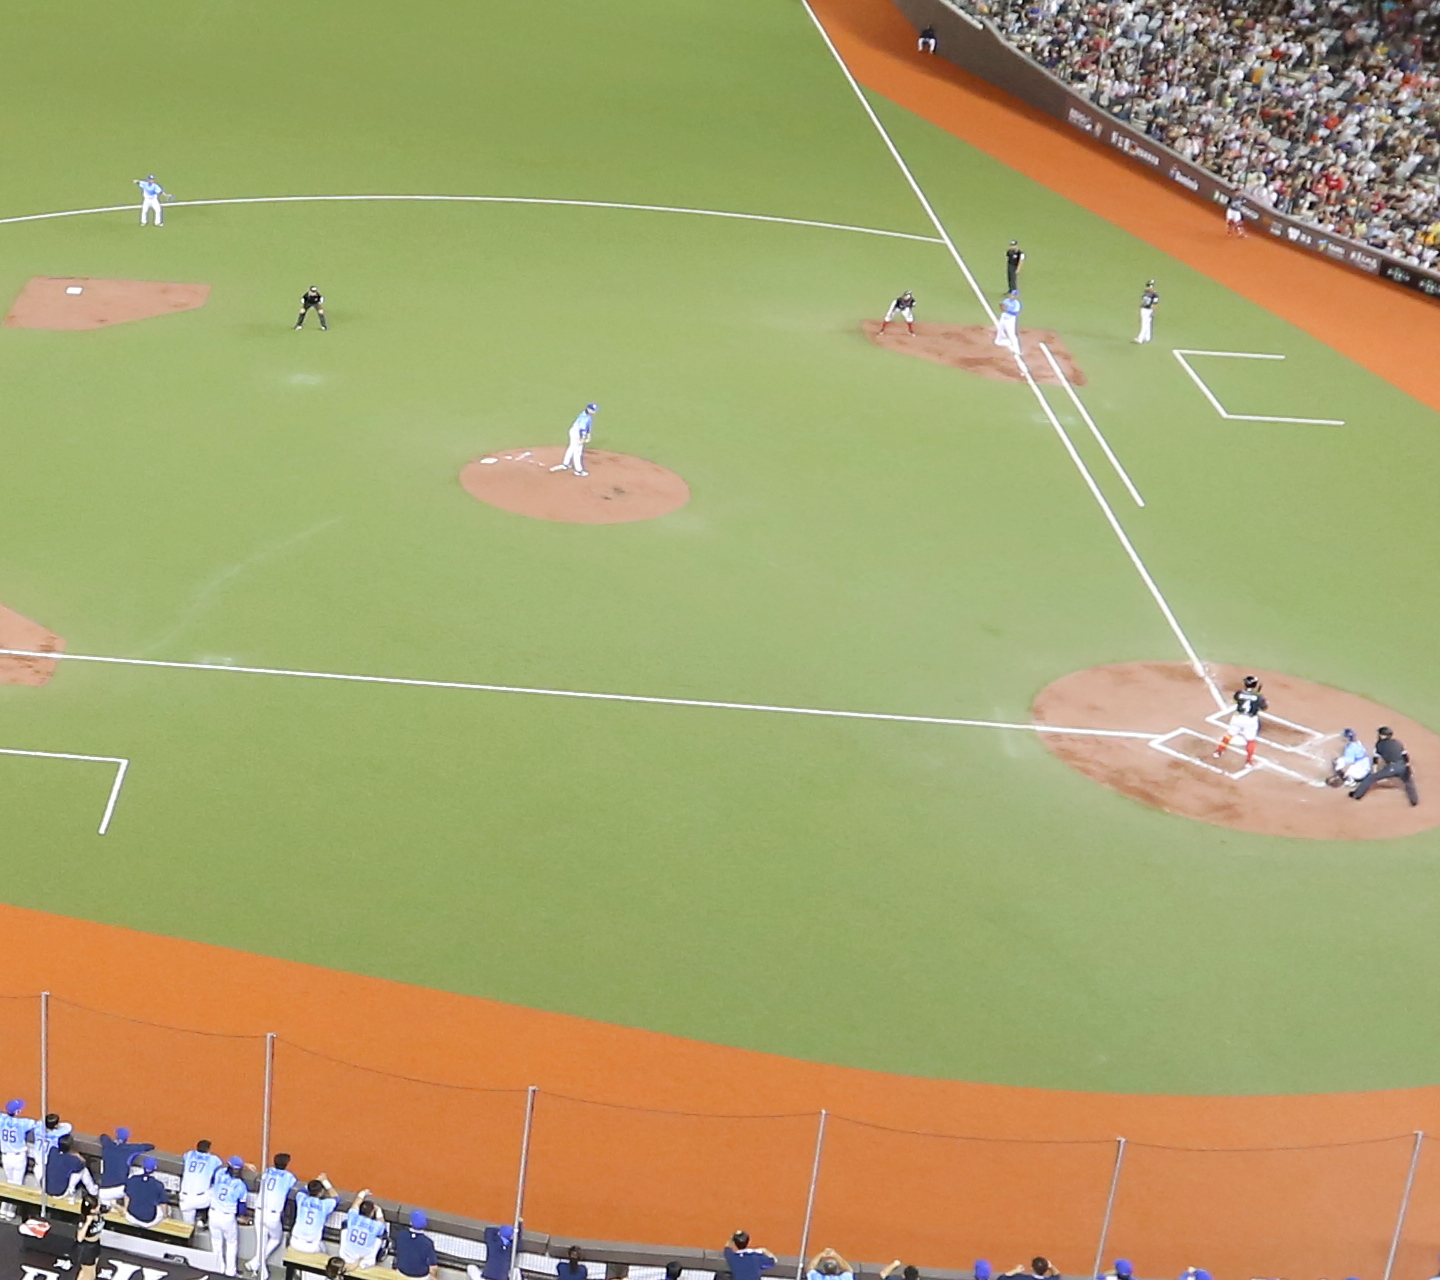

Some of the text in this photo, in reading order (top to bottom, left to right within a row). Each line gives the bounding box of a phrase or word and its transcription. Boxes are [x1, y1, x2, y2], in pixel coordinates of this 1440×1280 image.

[1240, 699, 1252, 714] 4
[2, 1129, 17, 1144] 85
[189, 1161, 207, 1175] 87
[220, 1187, 229, 1202] 2
[305, 1211, 315, 1226] 5
[349, 1228, 368, 1246] 69
